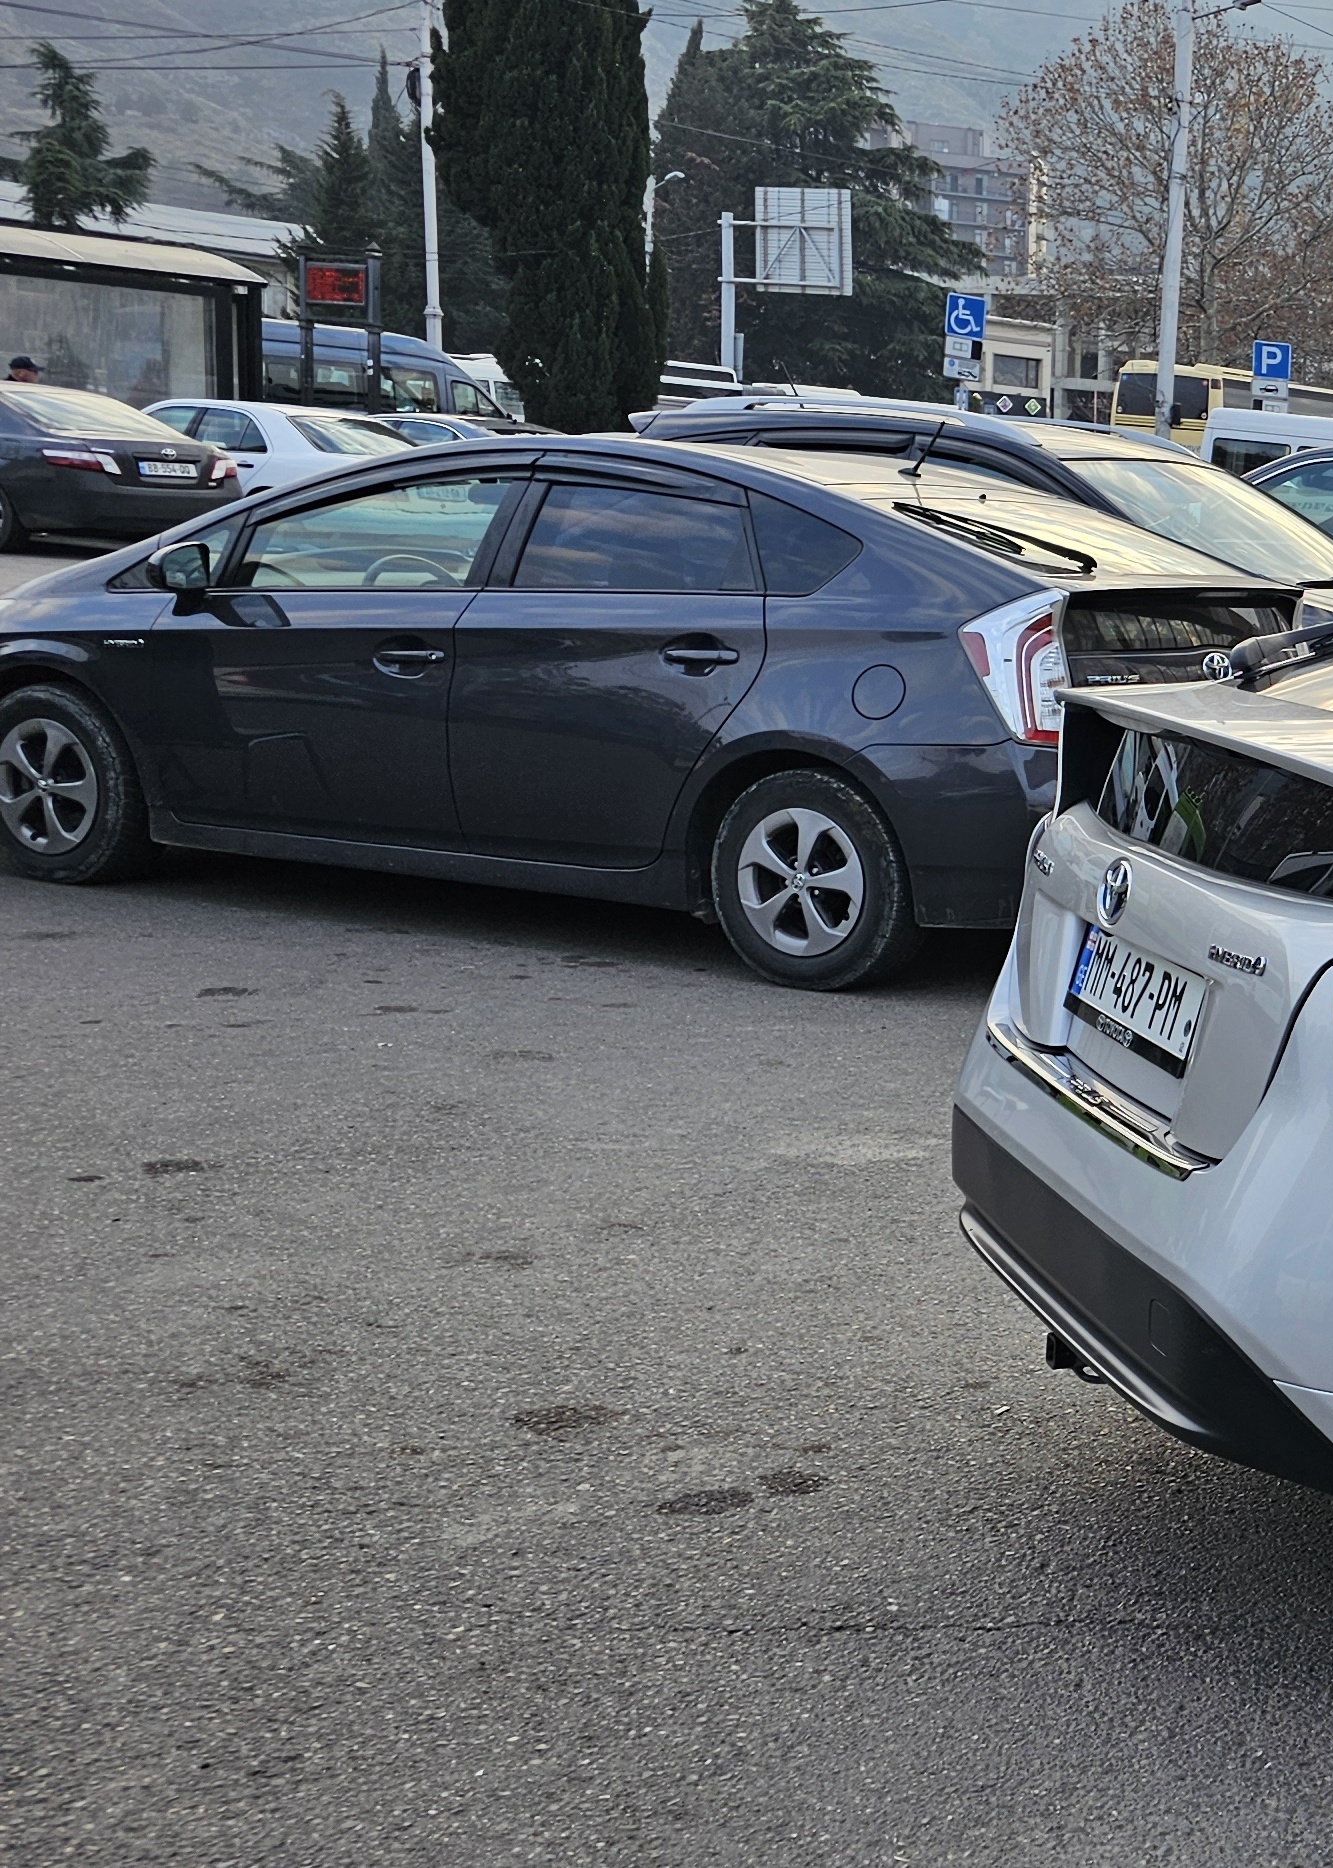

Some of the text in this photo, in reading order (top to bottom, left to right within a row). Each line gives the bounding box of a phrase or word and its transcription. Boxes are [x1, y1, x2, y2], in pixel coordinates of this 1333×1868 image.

[1261, 345, 1283, 375] P
[1086, 674, 1140, 684] PRIUS
[1083, 935, 1188, 1041] MM-487-PM
